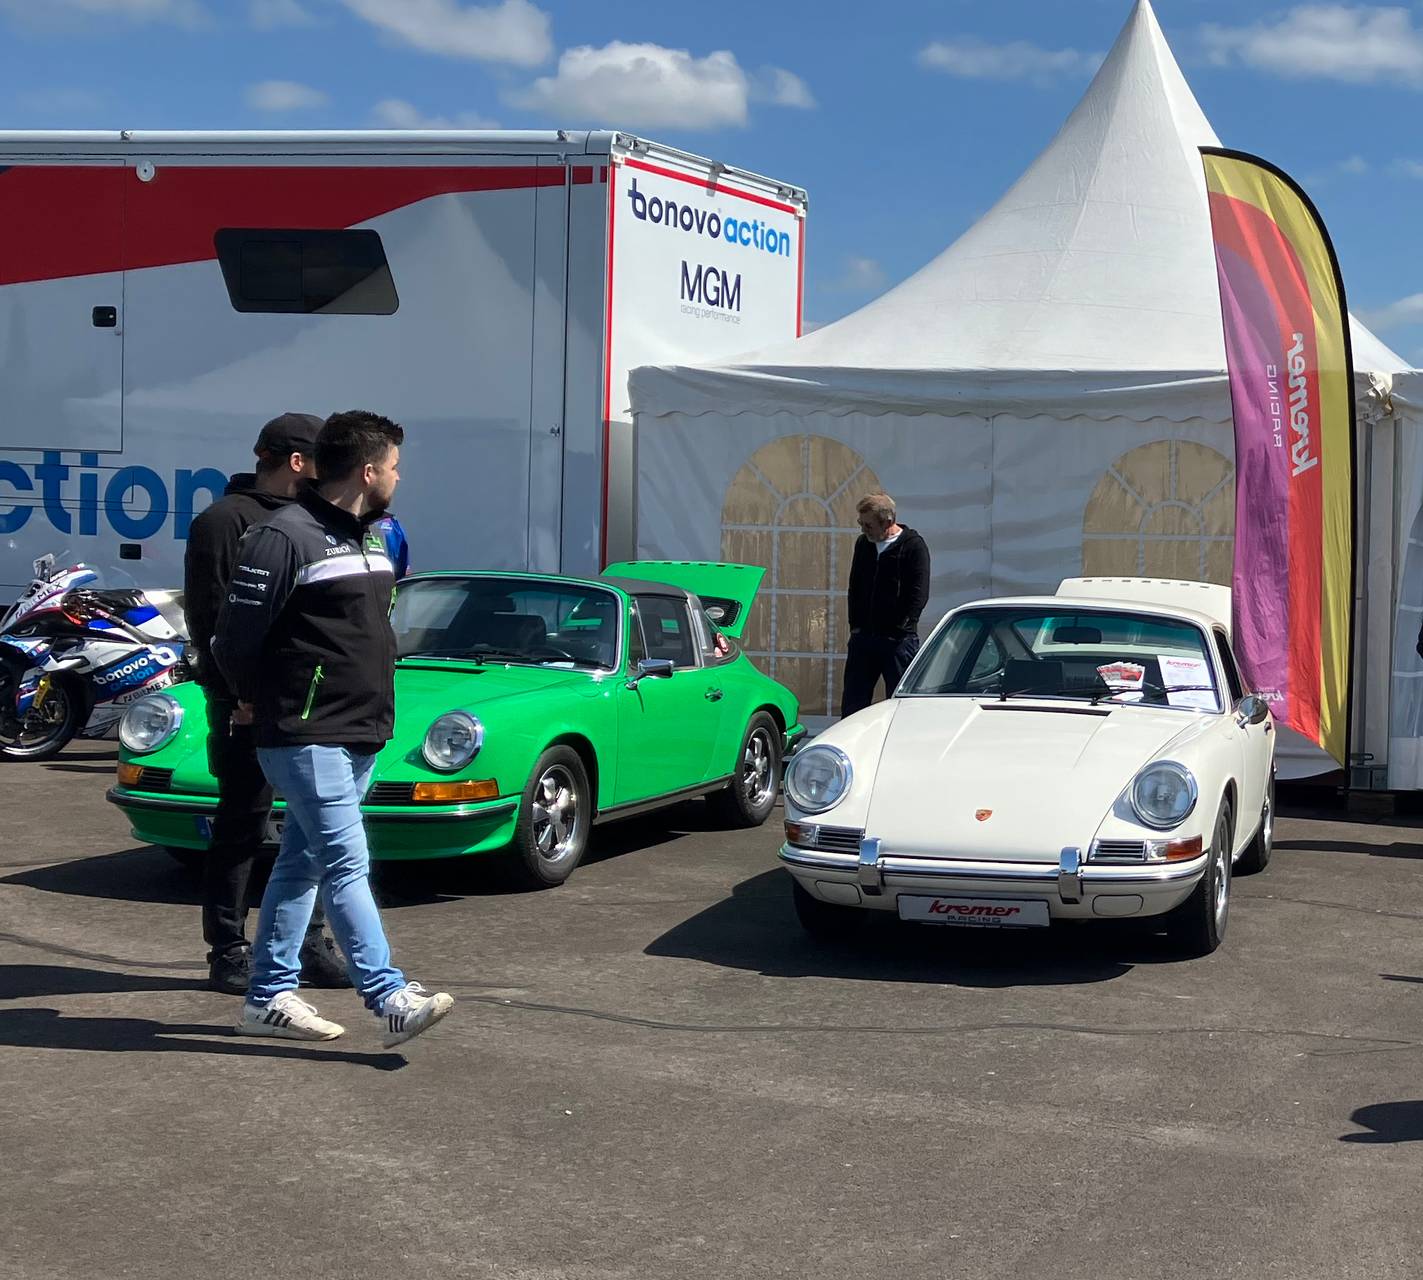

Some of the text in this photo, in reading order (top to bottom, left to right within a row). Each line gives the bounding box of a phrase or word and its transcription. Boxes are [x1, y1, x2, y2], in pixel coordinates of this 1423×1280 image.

[628, 178, 790, 257] bonovo action
[681, 260, 741, 311] MGM
[92, 657, 149, 685] bonovo
[928, 900, 1020, 916] kremer
[947, 915, 1001, 923] RACING
